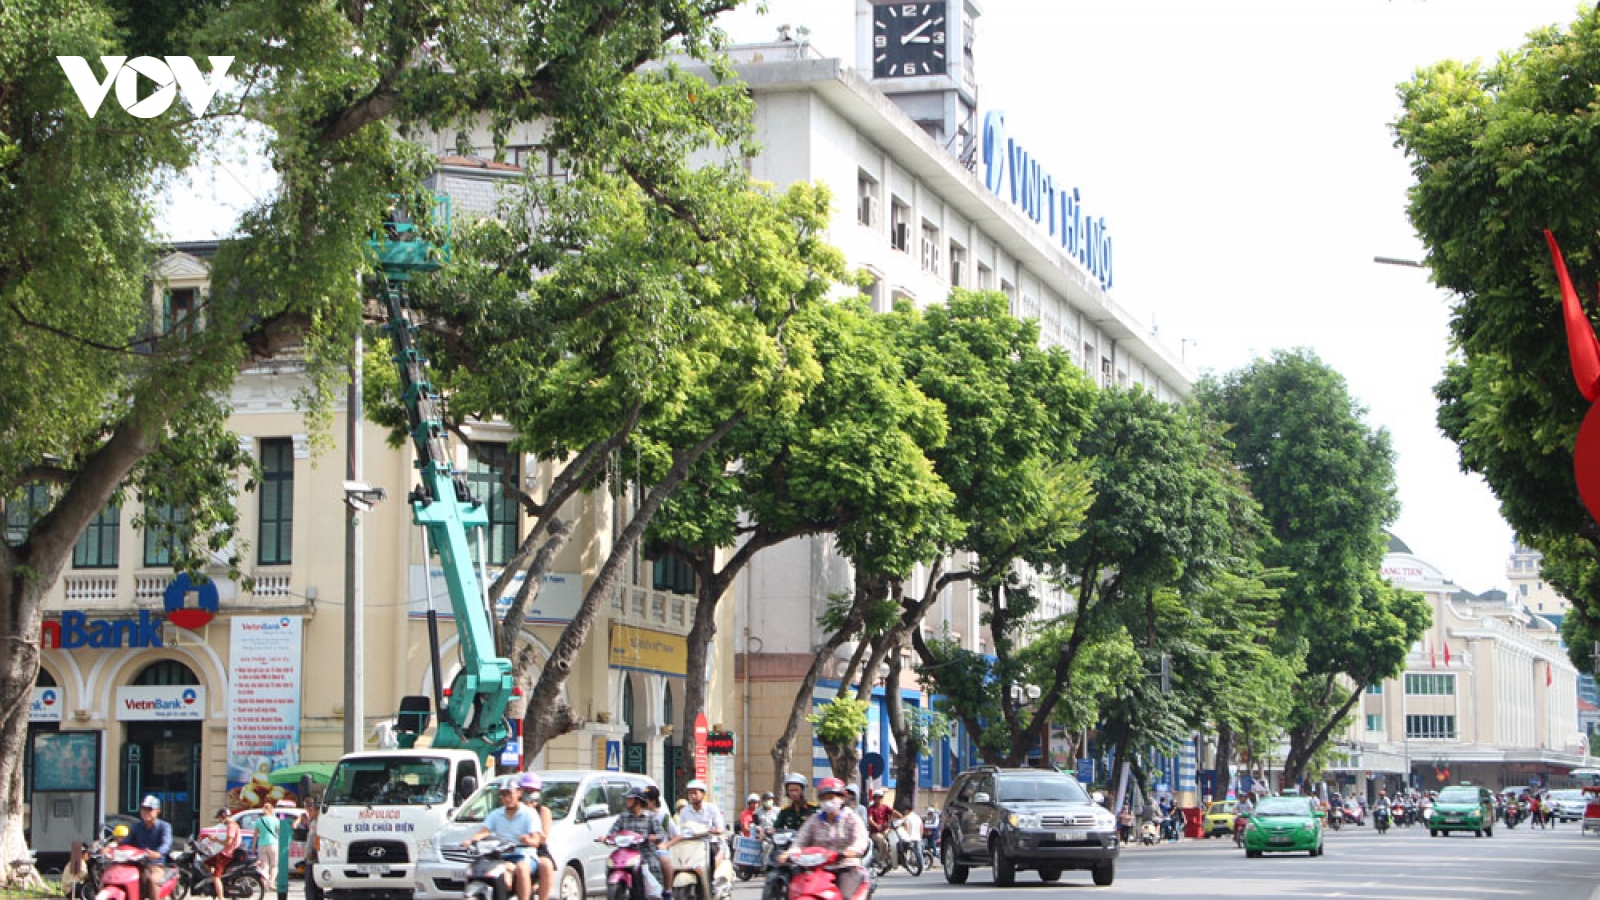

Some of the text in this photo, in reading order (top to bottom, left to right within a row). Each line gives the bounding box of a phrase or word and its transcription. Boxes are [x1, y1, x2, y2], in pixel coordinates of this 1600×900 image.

[932, 32, 944, 44] 3
[904, 63, 916, 75] 6
[1008, 138, 1057, 238] VNPT
[125, 698, 181, 710] VietinBank
